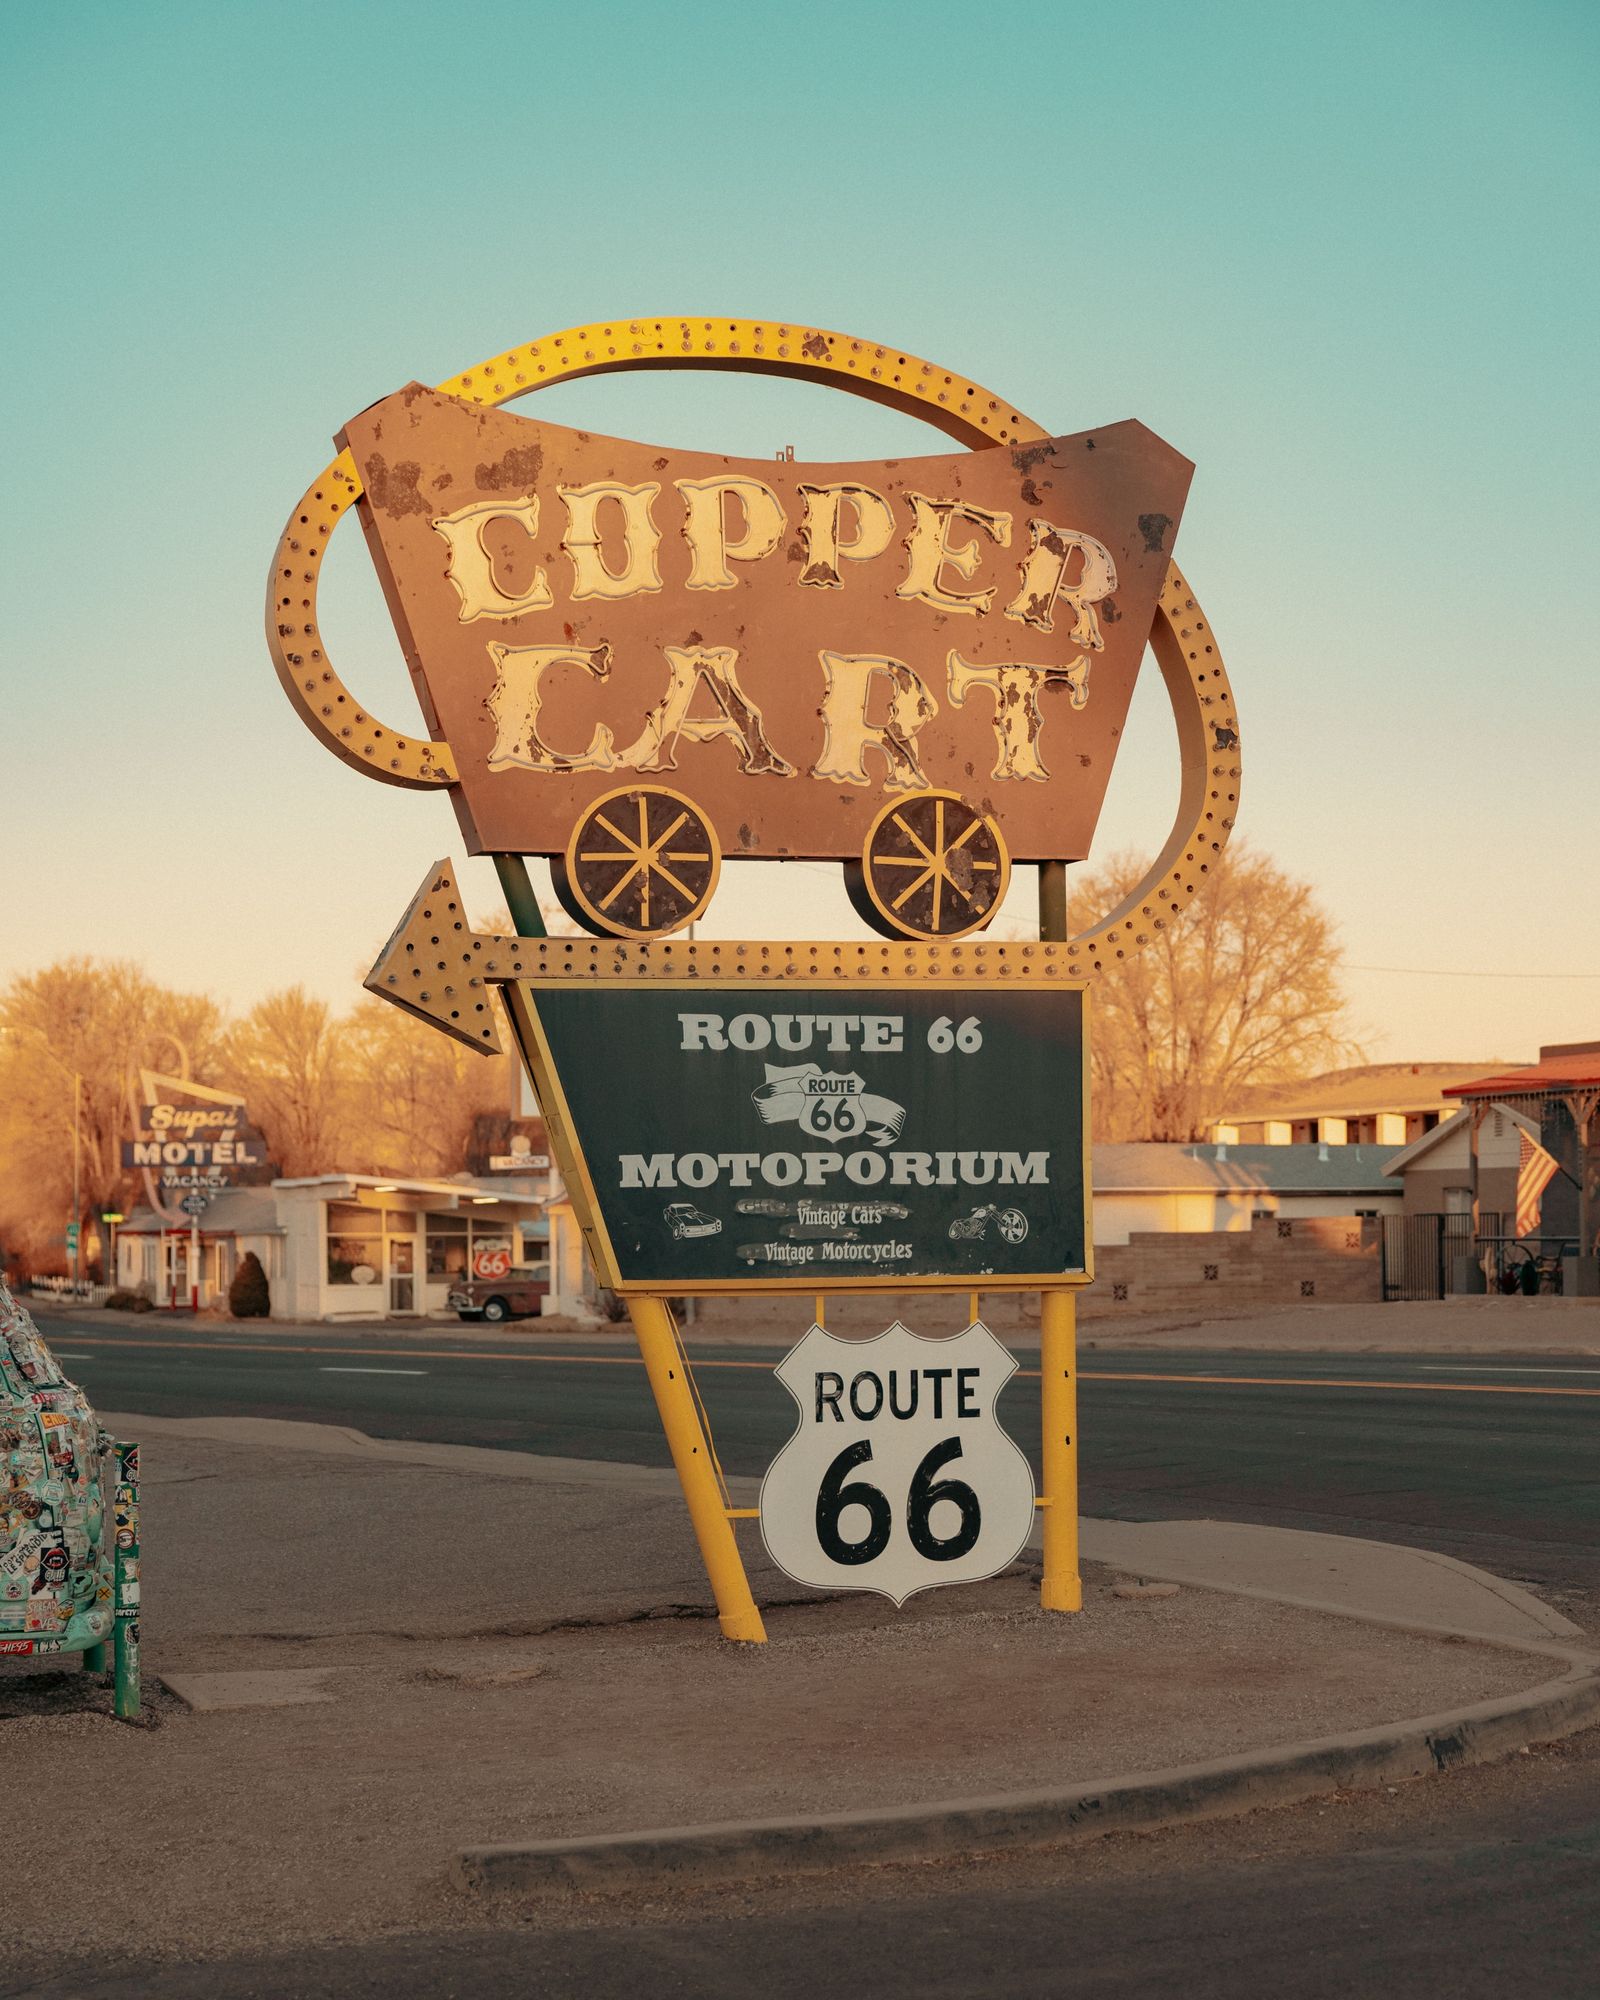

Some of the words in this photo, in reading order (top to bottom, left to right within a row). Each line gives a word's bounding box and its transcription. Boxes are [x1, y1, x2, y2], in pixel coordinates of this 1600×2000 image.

[432, 474, 1119, 653] COPPER
[482, 641, 1091, 792] CART
[677, 1013, 904, 1052] ROUTE
[926, 1015, 984, 1054] 66
[807, 1078, 856, 1095] ROUTE
[149, 1104, 239, 1138] Supai
[809, 1098, 856, 1133] 66
[133, 1141, 257, 1165] MOTEL
[618, 1151, 1050, 1188] MOTOPORIUM
[162, 1175, 229, 1188] VACANCY
[797, 1206, 846, 1229] Vintage
[851, 1206, 883, 1225] Cars
[479, 1253, 506, 1275] 66
[763, 1242, 814, 1265] Vintage
[822, 1239, 913, 1263] Motorcycles
[815, 1367, 981, 1423] ROUTE
[815, 1436, 981, 1566] 66
